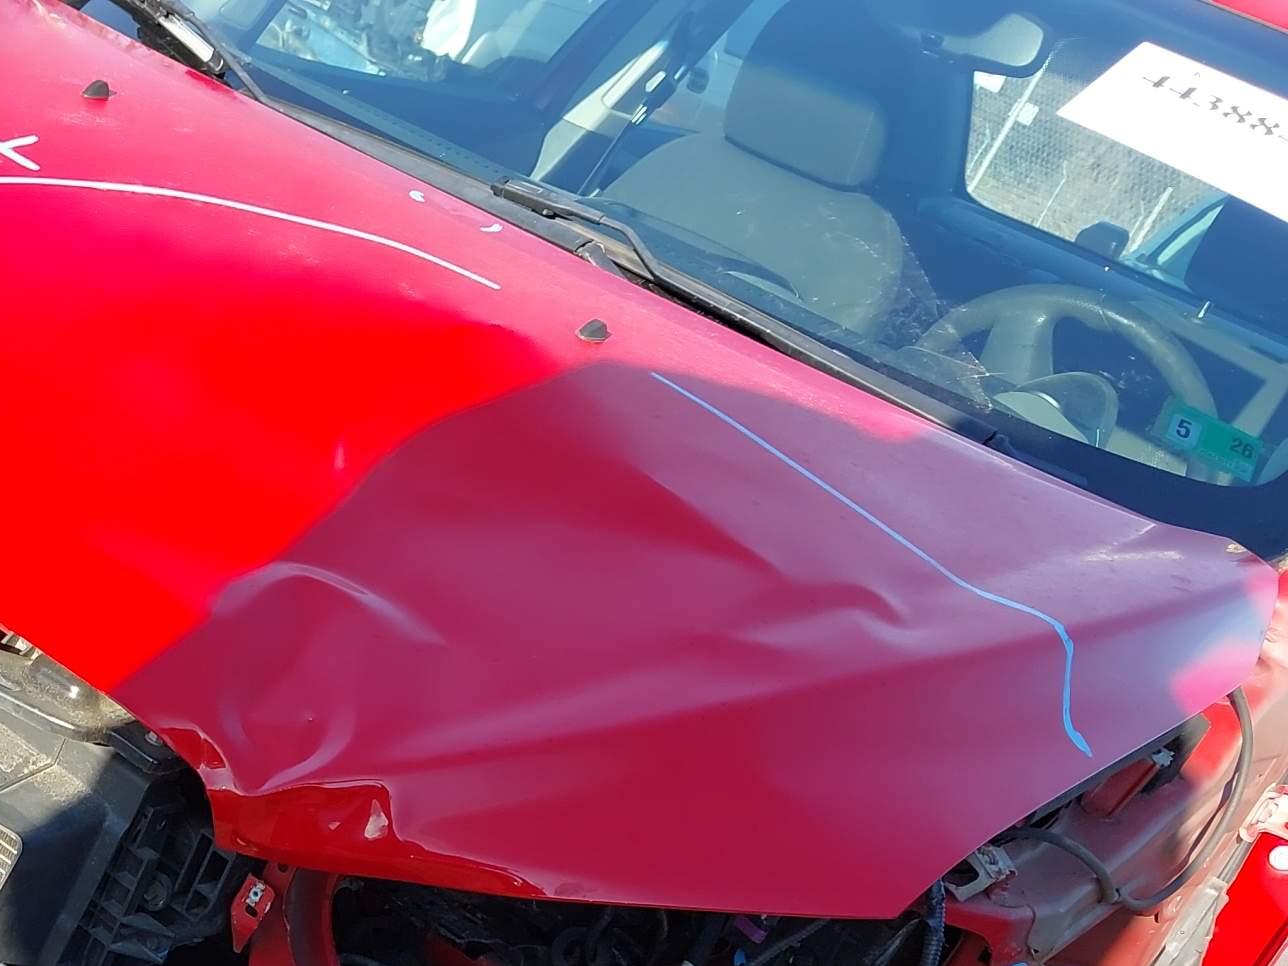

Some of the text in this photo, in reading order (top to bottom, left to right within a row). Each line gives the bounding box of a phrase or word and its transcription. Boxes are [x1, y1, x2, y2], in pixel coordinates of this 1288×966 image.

[1142, 74, 1288, 142] 44388
[1175, 418, 1255, 459] 5 26
